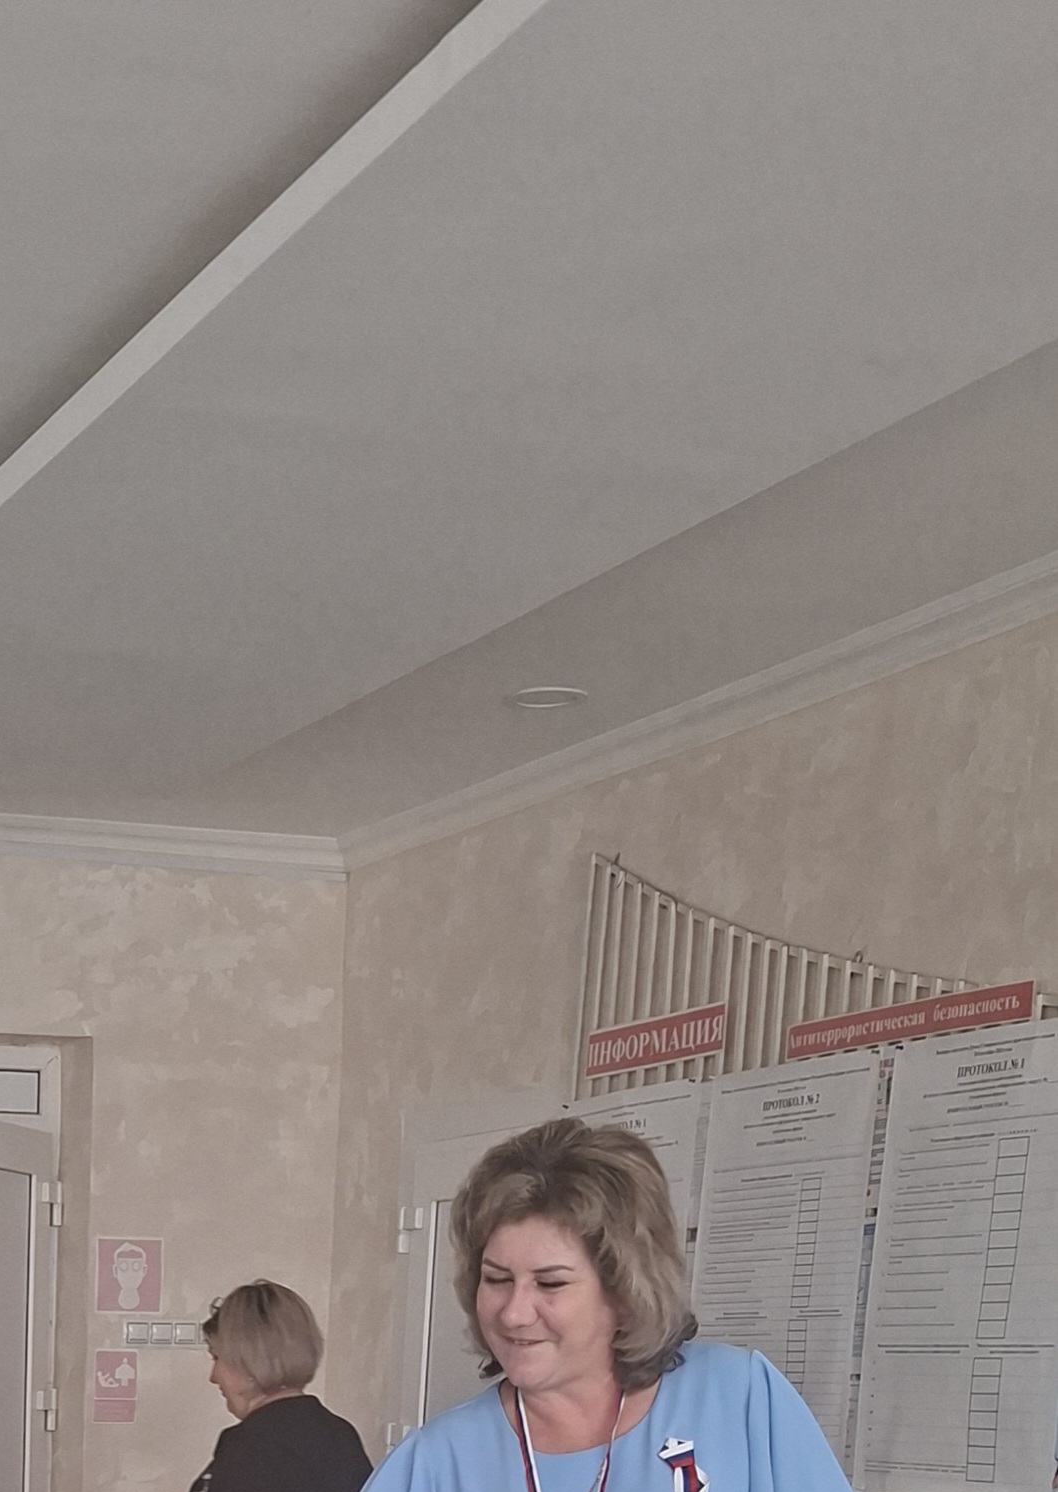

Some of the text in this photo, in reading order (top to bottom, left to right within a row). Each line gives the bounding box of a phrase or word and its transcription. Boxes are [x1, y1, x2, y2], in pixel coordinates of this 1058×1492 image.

[790, 1010, 925, 1048] Антитеррористическая
[933, 995, 1020, 1023] безопасность
[588, 1014, 725, 1068] ИНФОРМАЦИЯ
[957, 1060, 1007, 1078] ПРОТОКОЛ
[763, 1096, 804, 1111] ПРОТОКОЛ
